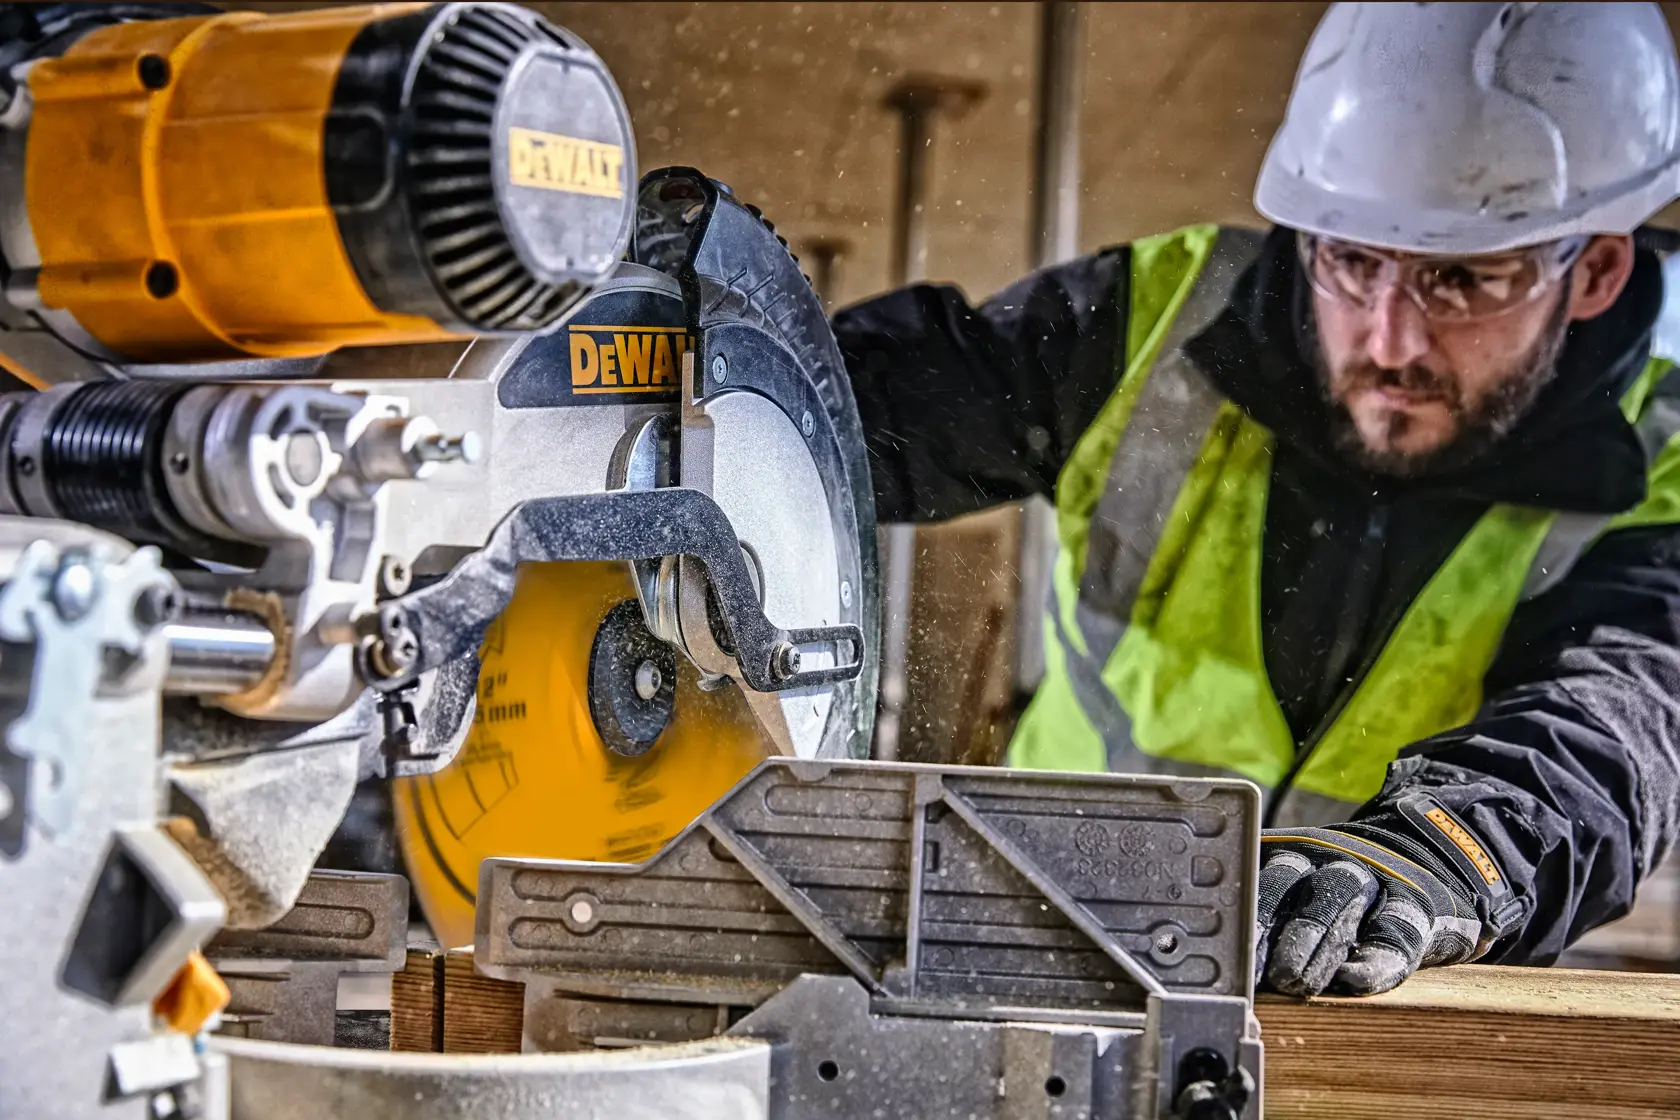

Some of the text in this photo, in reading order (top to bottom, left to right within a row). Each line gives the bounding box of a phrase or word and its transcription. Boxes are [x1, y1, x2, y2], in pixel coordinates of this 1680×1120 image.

[568, 333, 696, 386] DEWA
[483, 672, 508, 698] 2"
[475, 700, 527, 725] 5mm
